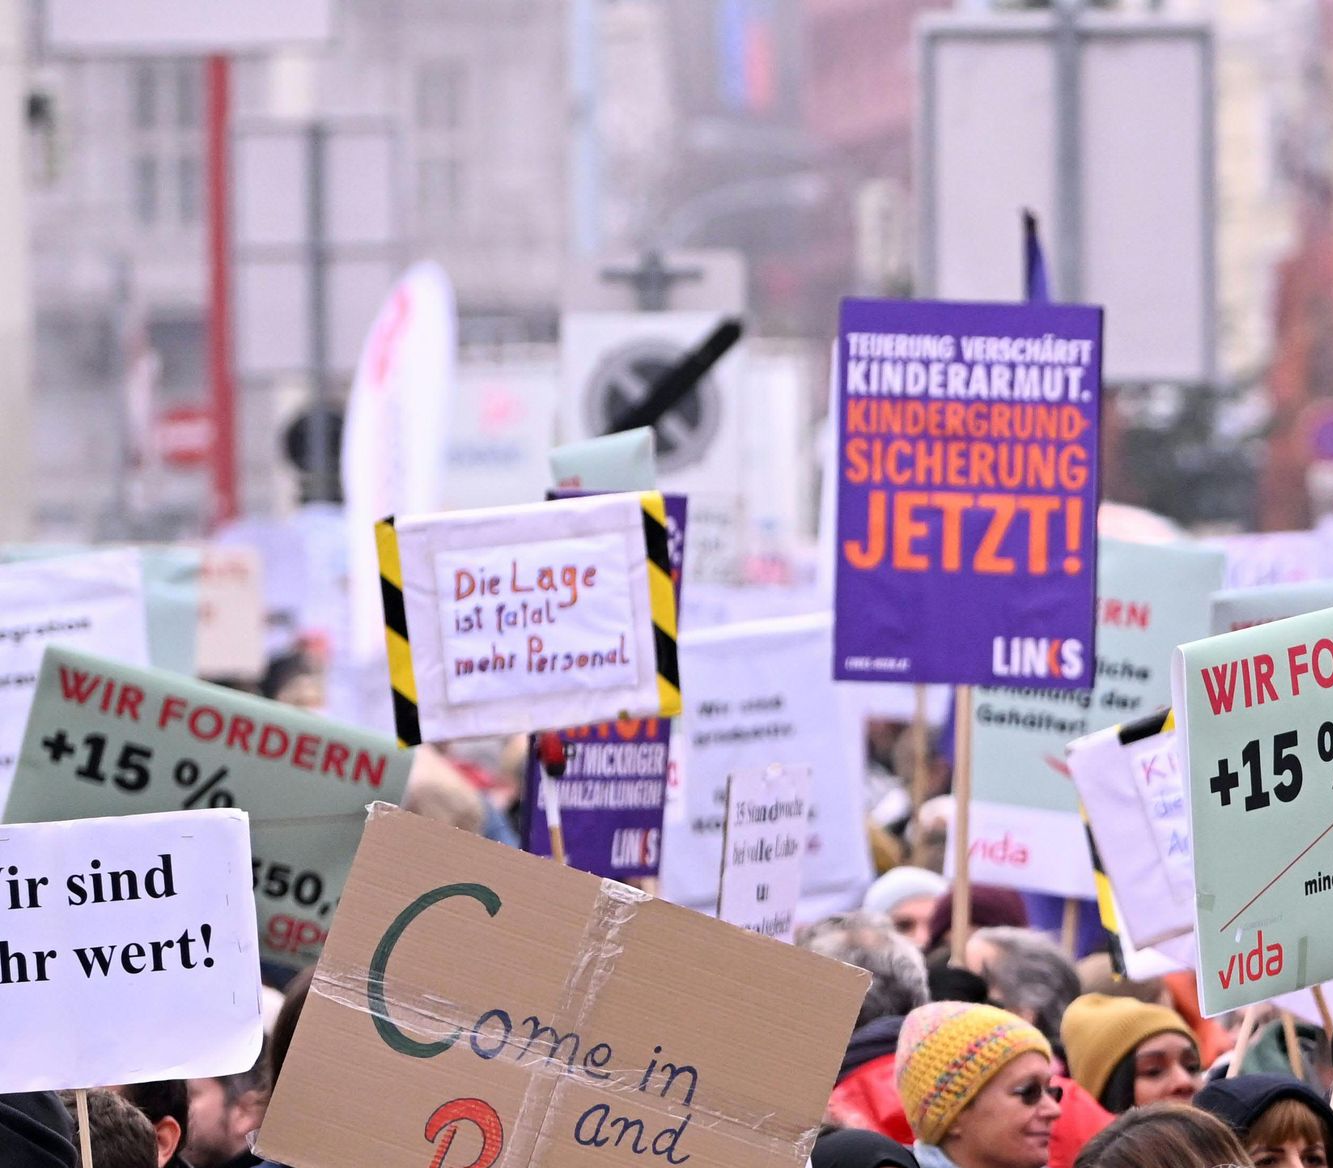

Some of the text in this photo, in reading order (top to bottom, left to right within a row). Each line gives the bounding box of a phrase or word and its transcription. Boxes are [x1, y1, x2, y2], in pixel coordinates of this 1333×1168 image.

[847, 332, 1093, 366] TEUERUNG VERSCHÄRFT
[847, 360, 1092, 403] KINDERARMUT.
[847, 399, 1091, 441] KINDERGRUND-
[845, 438, 1089, 491] SICHERUNG
[843, 489, 1083, 576] JETZT!
[454, 559, 597, 608] Die Lage
[455, 600, 555, 633] ist fatal
[455, 635, 630, 677] mehr Personal
[992, 635, 1084, 680] LINKS
[1201, 654, 1279, 715] WIR
[59, 665, 388, 789] WIR FORDERN
[41, 728, 235, 808] +15 %
[583, 742, 668, 776] MICKRIGER
[1210, 729, 1303, 811] +15
[537, 780, 664, 811] MALZAHLUNGEN
[0, 853, 178, 910] ir sind
[252, 858, 330, 916] 50,
[0, 923, 215, 984] hr wert!
[266, 914, 328, 957] gp
[1218, 930, 1283, 989] vida
[368, 883, 699, 1107] Come in
[574, 1104, 691, 1165] and
